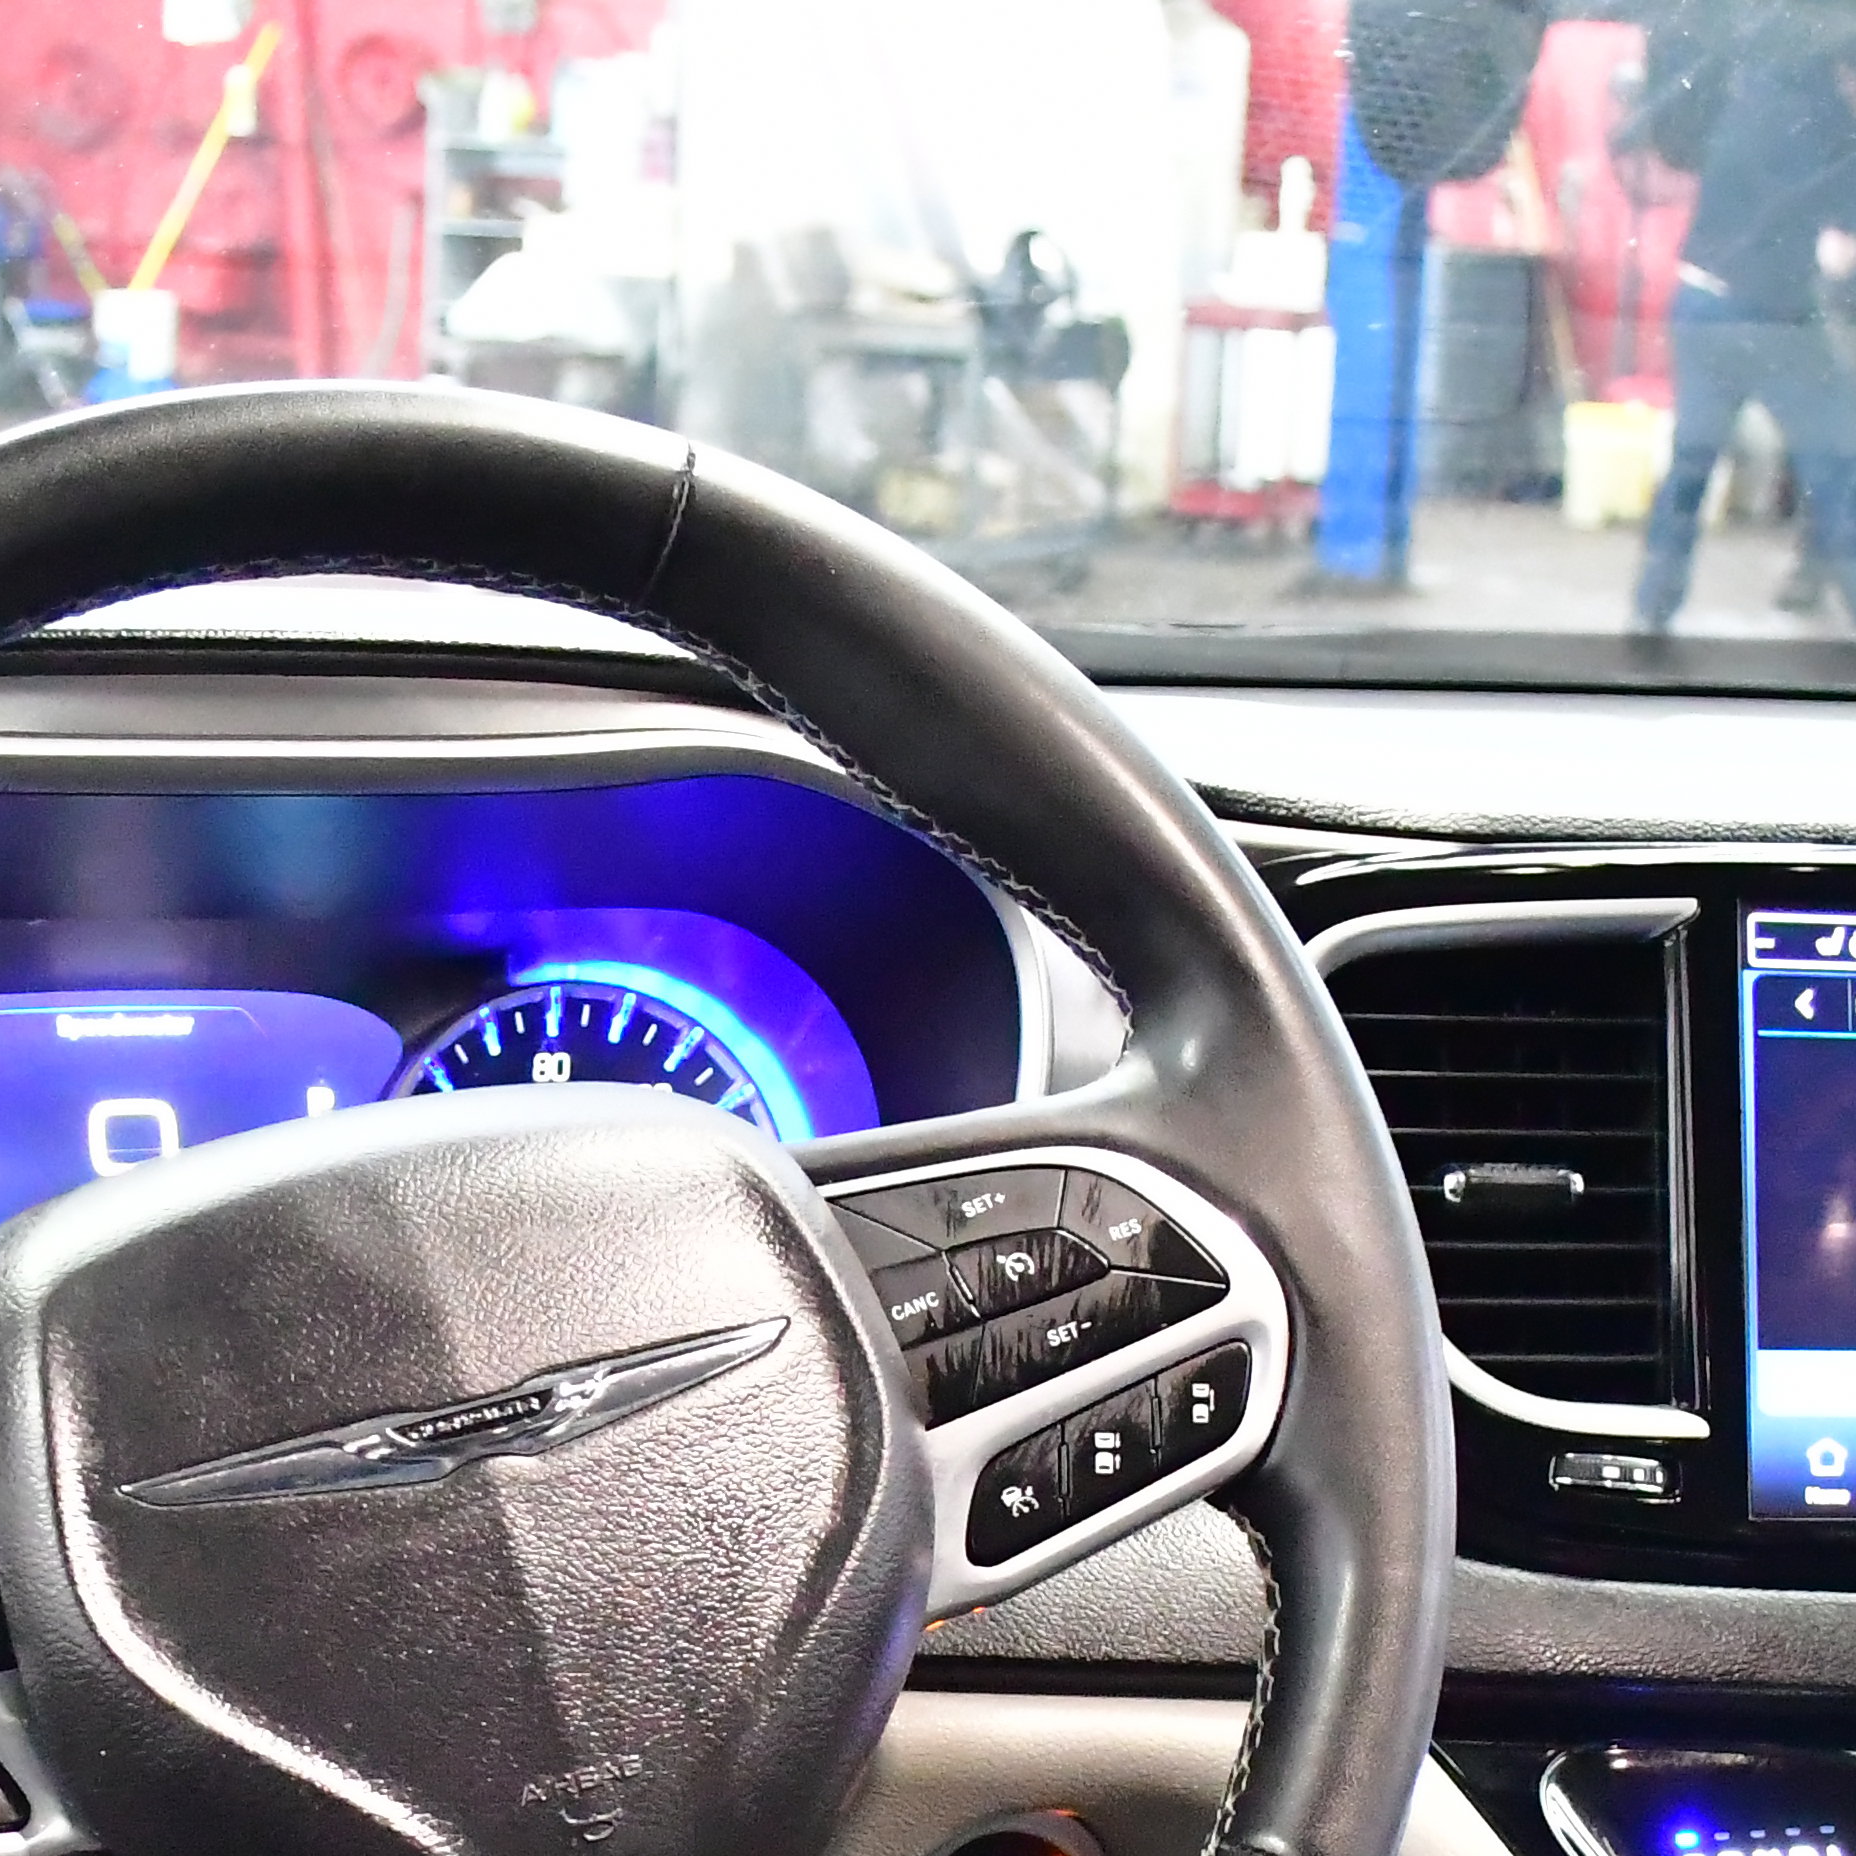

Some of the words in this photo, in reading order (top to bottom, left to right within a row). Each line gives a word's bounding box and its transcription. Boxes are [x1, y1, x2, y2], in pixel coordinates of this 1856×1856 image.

[532, 1052, 571, 1082] 80
[1109, 1217, 1142, 1242] RES
[891, 1291, 940, 1321] CANC
